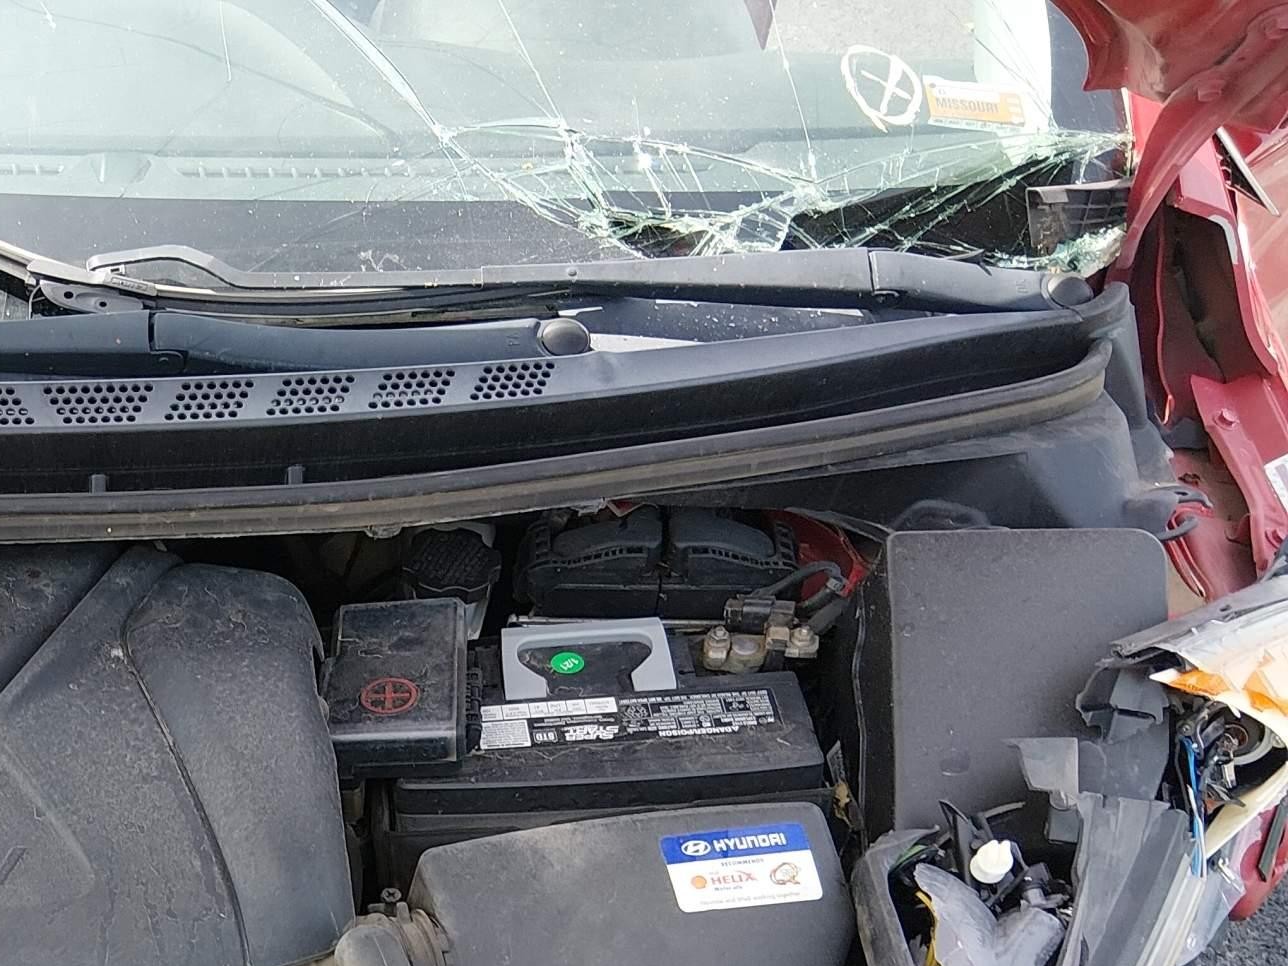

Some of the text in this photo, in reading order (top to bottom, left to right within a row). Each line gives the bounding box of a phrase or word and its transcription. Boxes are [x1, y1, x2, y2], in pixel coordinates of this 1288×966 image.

[935, 97, 1000, 113] MISSOURI
[565, 732, 615, 741] SUPER
[712, 832, 787, 852] HYUNDAI
[710, 870, 757, 885] HELIX
